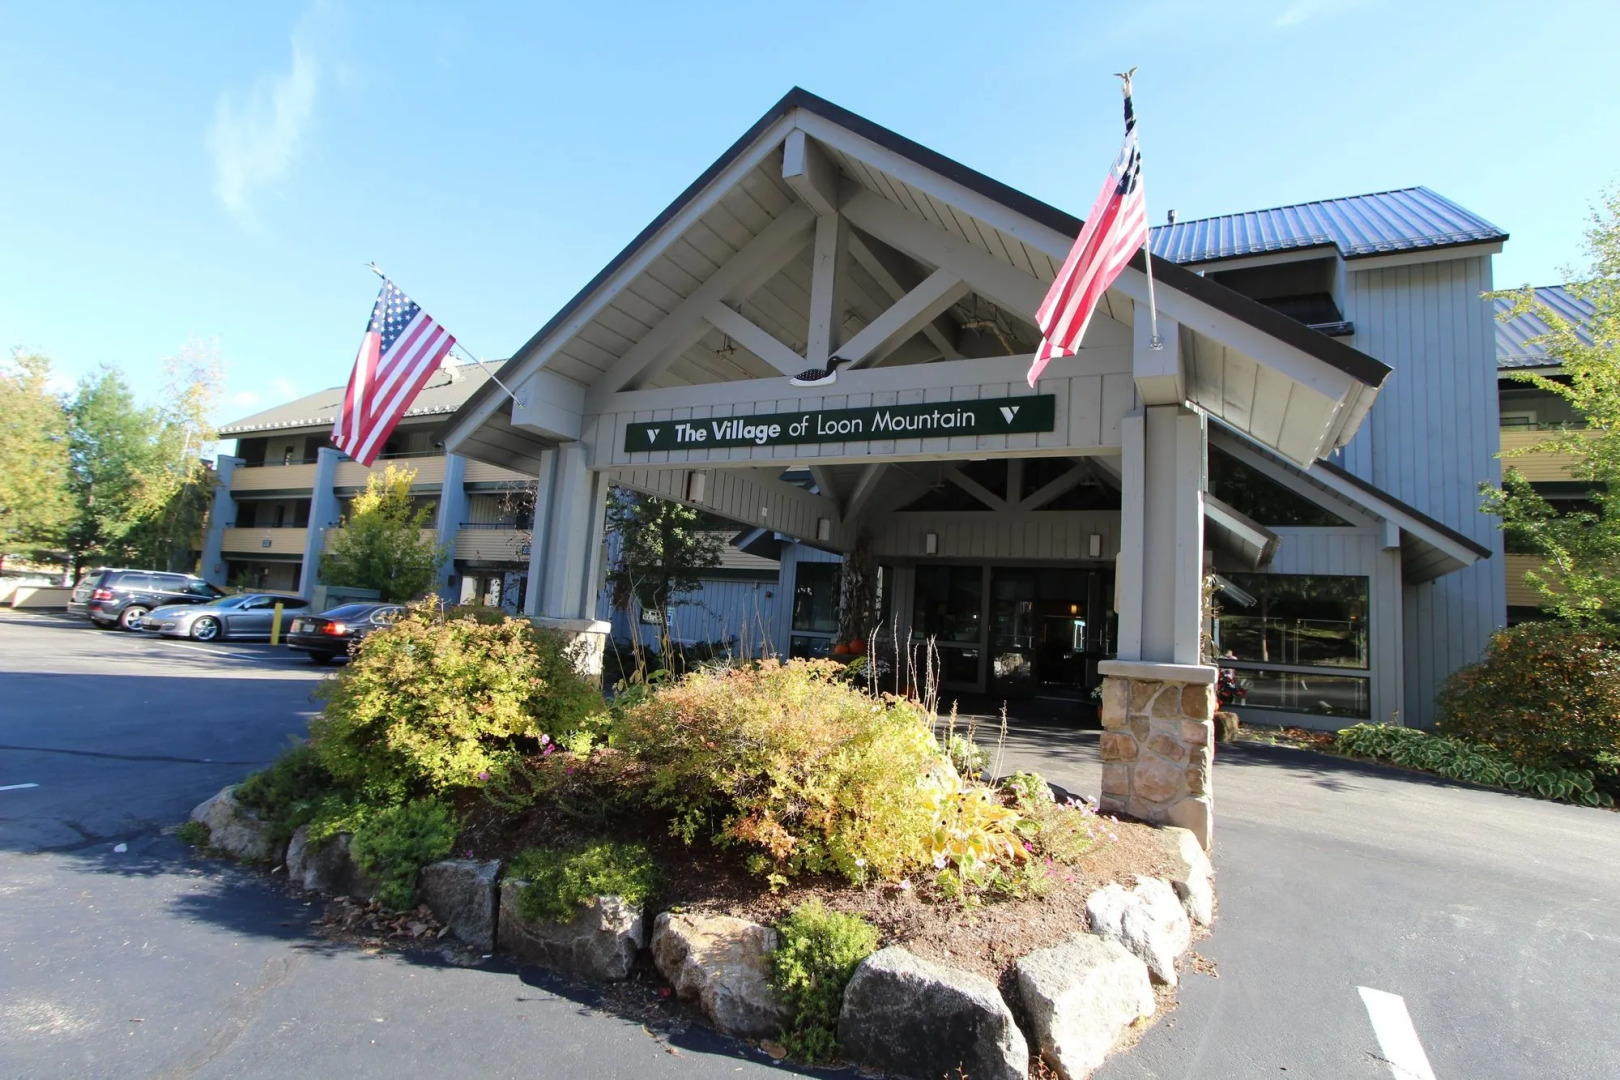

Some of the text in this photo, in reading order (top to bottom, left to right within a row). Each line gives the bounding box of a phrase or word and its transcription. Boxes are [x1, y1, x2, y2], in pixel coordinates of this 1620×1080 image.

[675, 408, 975, 444] The Village of Loon Mountain
